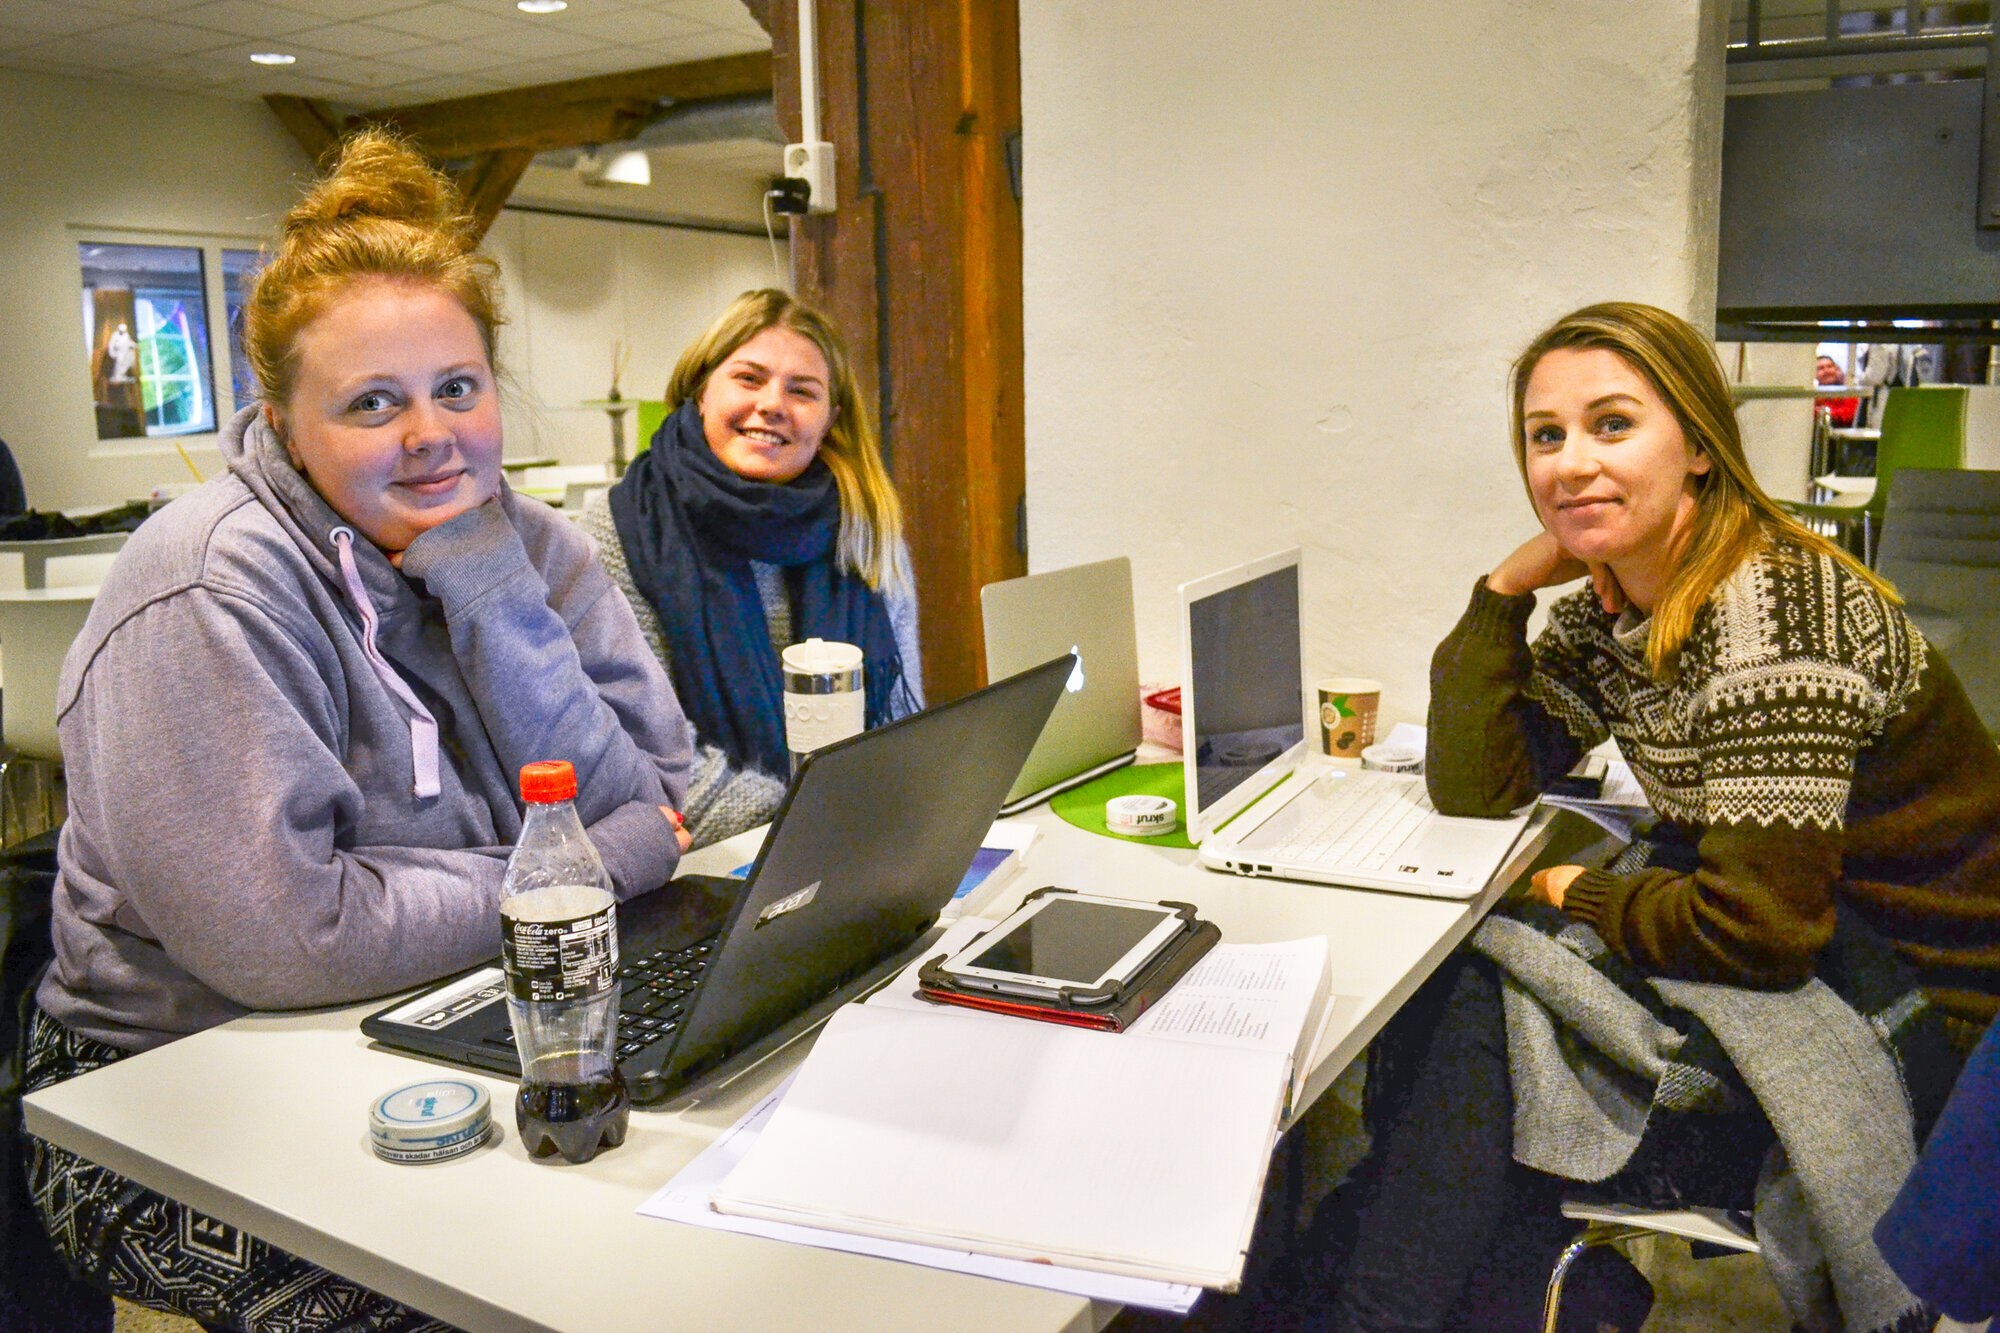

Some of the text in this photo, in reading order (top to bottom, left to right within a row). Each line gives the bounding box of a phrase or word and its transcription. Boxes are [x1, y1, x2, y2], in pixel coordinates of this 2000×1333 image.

[1136, 814, 1165, 825] skruf
[767, 889, 809, 920] acer
[544, 928, 564, 936] zero
[405, 1151, 431, 1159] skadar
[460, 1140, 473, 1151] och
